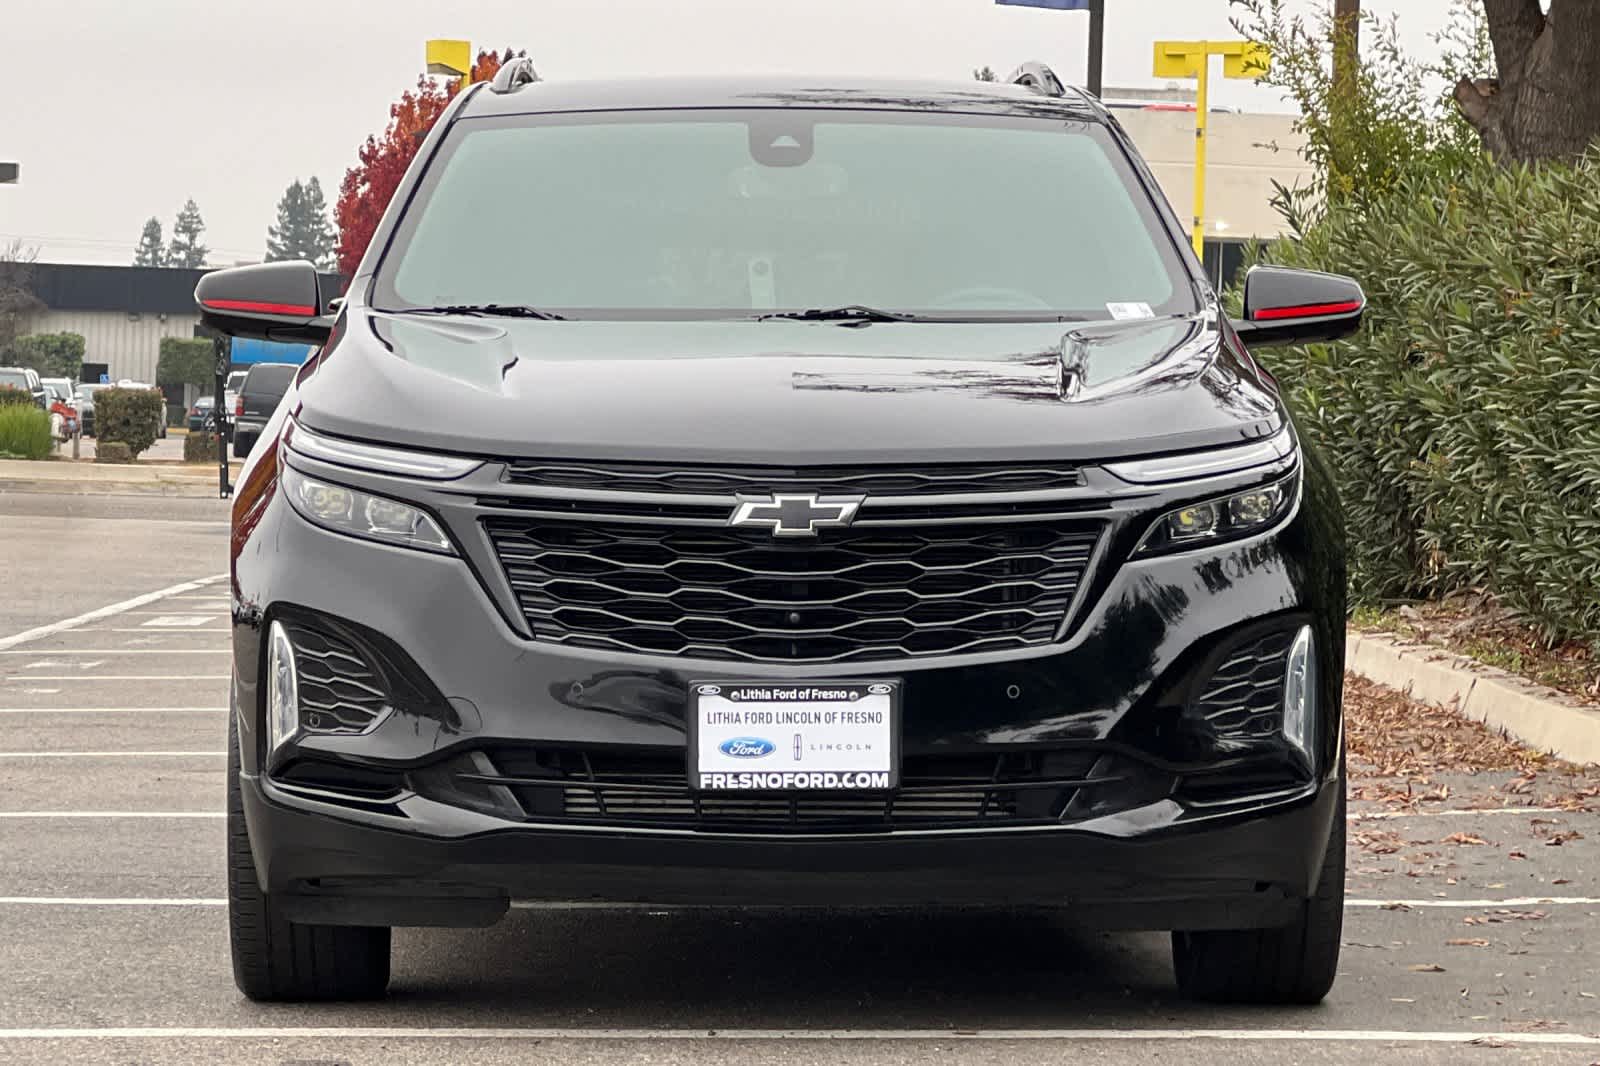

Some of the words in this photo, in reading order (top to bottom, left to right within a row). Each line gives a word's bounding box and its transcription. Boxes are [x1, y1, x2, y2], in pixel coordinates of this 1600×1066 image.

[741, 689, 772, 700] Lithia
[773, 689, 798, 700] Ford
[799, 689, 809, 700] of
[811, 689, 848, 700] Fresno
[707, 711, 742, 725] LITHIA
[744, 711, 773, 725] FORD
[775, 711, 821, 725] LINCOLN
[824, 711, 839, 724] OF
[841, 711, 883, 724] FRESNO
[729, 738, 765, 756] Ford
[810, 743, 872, 751] LINCOLN
[700, 773, 889, 789] FRESNOFORD.COM
